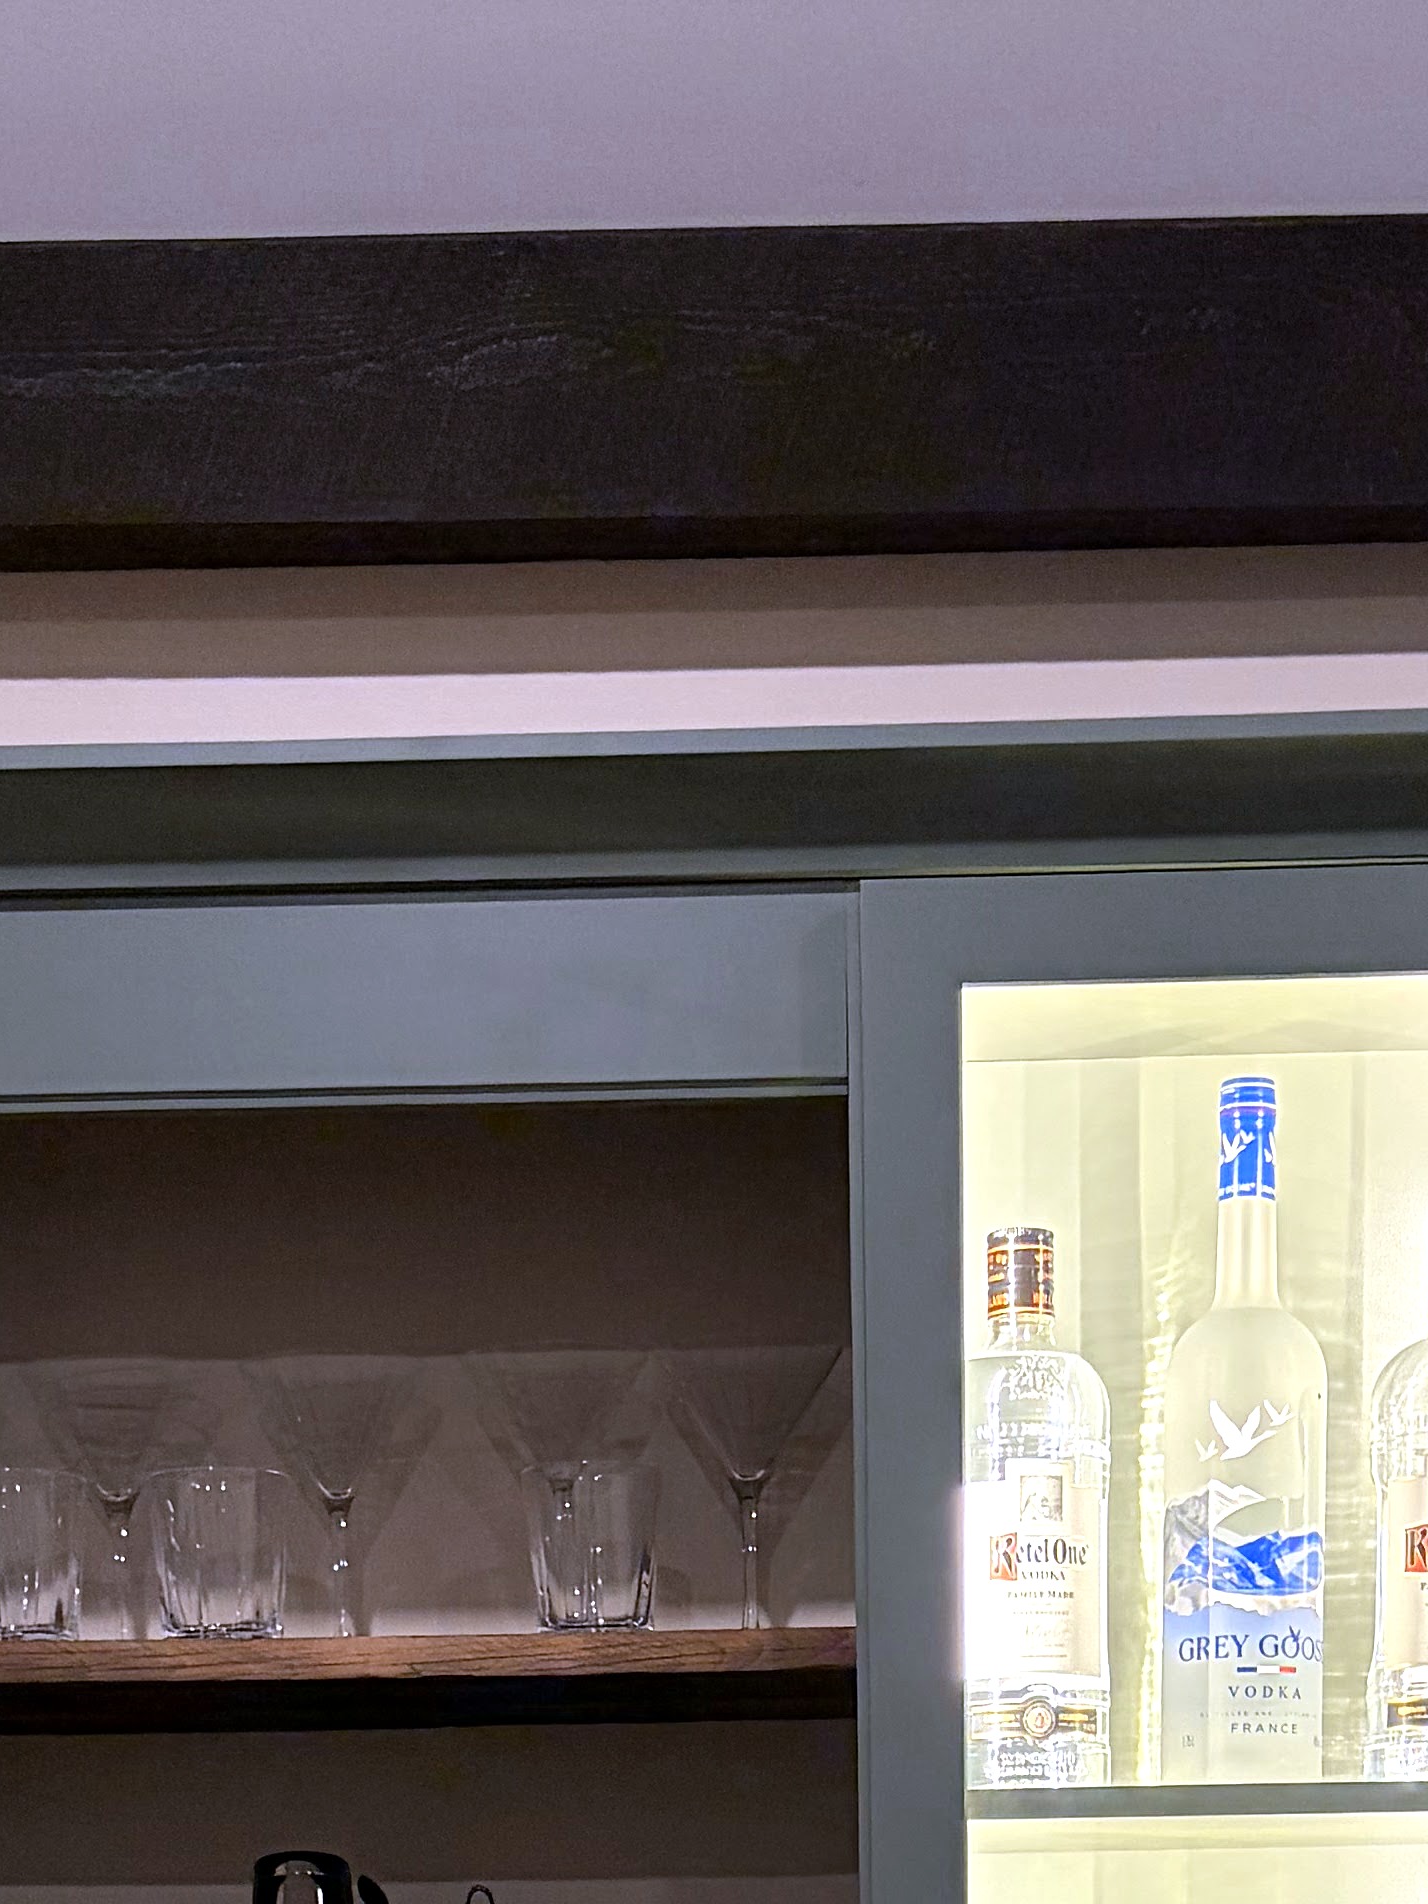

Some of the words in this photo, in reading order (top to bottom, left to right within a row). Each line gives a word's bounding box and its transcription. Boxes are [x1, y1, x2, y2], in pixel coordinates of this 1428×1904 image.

[990, 1532, 1049, 1581] Ketel
[1053, 1538, 1088, 1566] One
[1178, 1634, 1250, 1662] GREY
[1258, 1625, 1323, 1662] GOOS
[1228, 1685, 1302, 1700] VODKA
[1230, 1722, 1298, 1734] FRANCE
